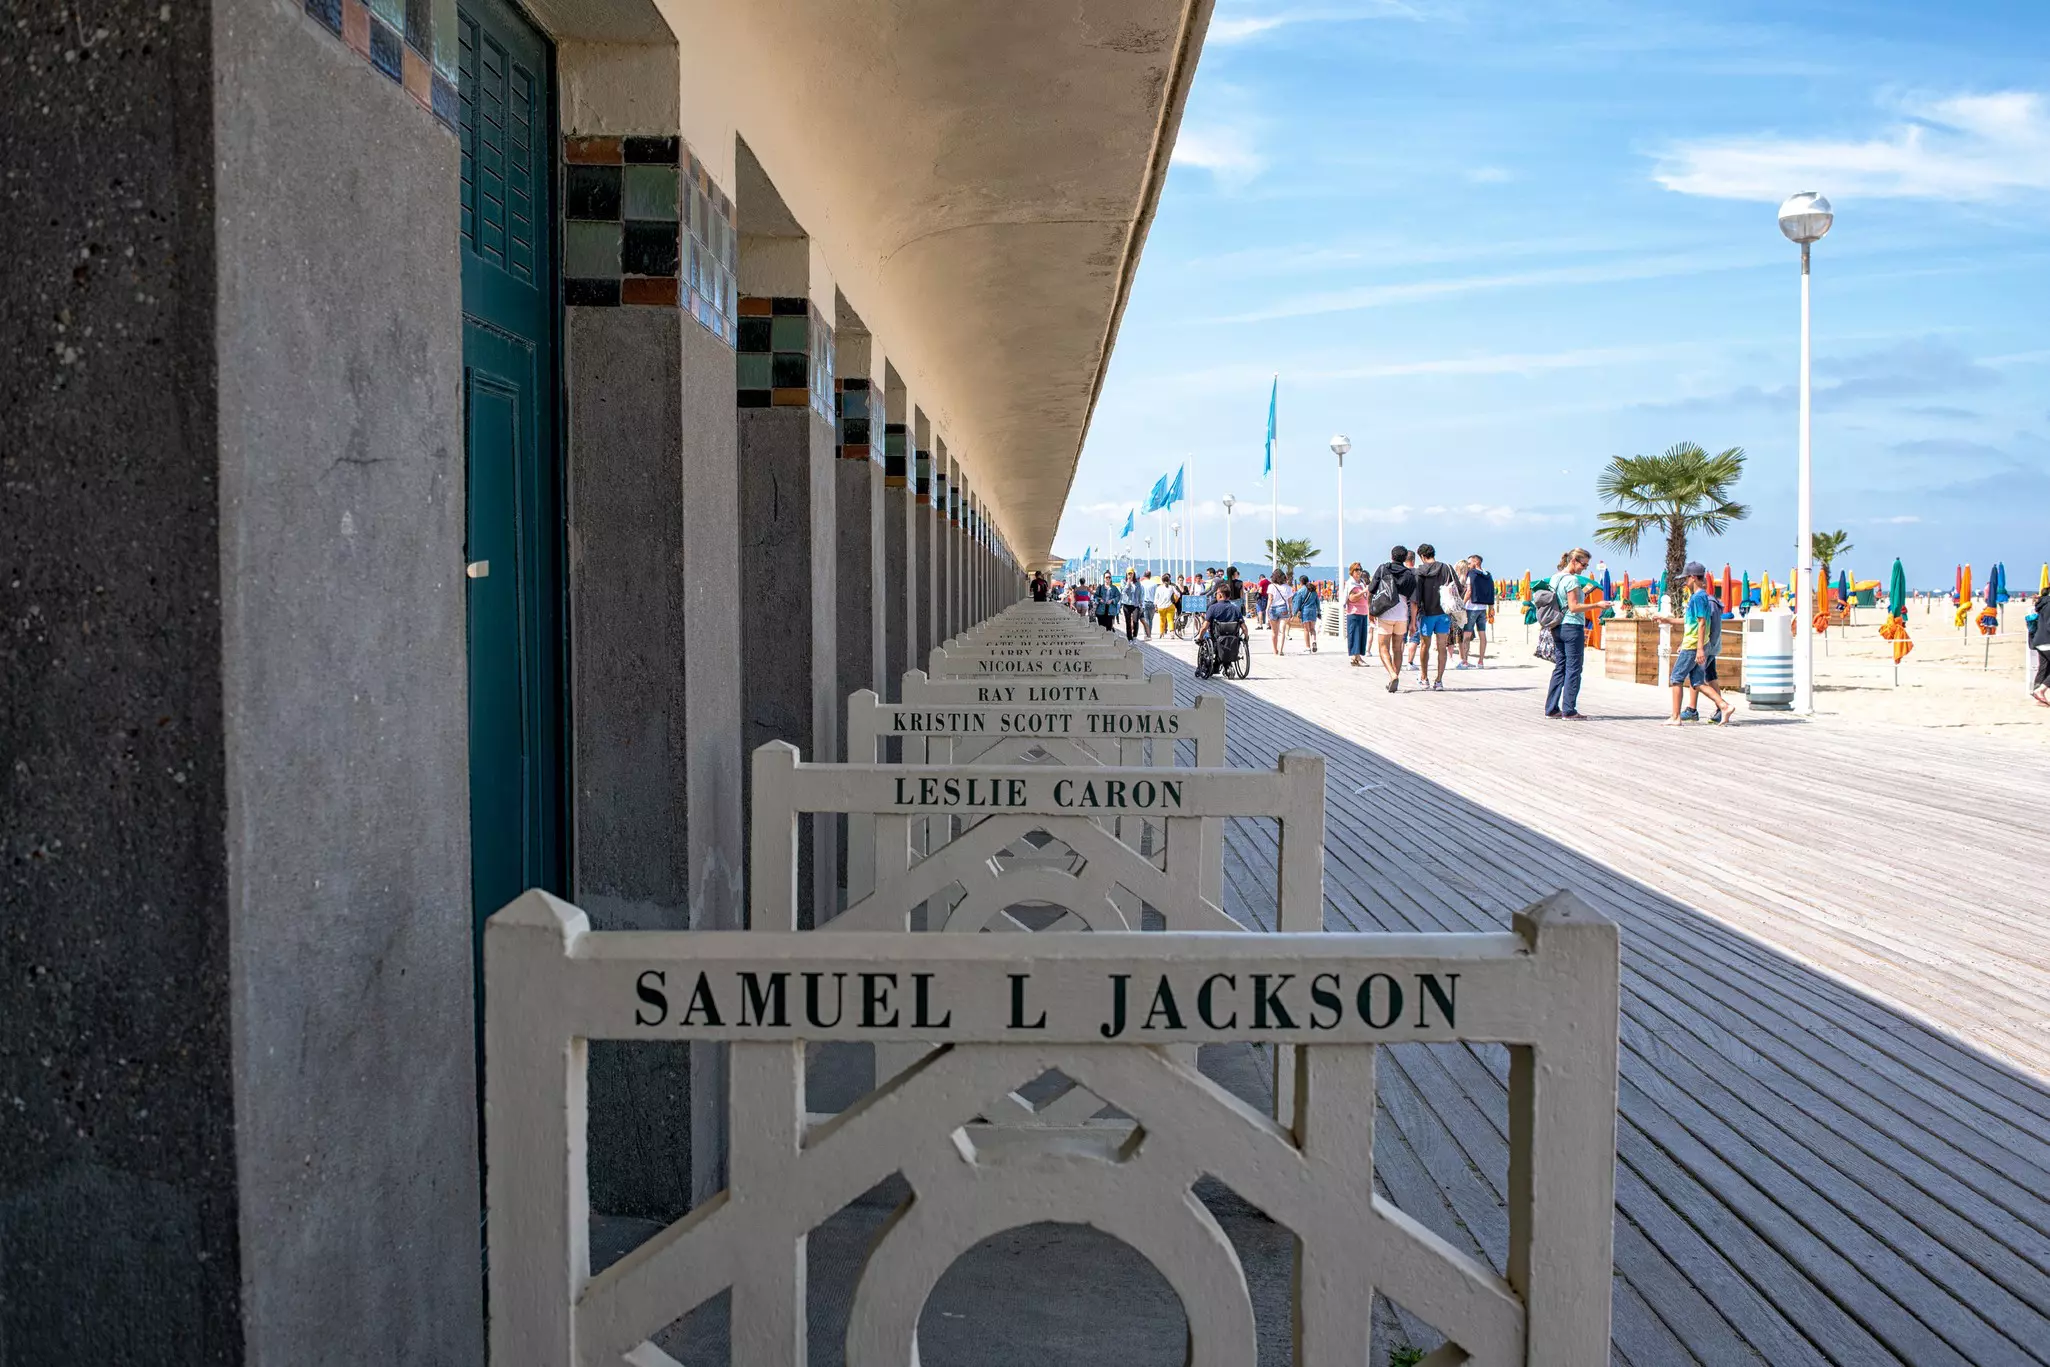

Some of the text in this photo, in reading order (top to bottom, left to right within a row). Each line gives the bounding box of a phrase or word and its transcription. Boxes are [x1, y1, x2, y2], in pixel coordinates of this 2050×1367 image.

[978, 660, 1093, 672] NICOLAS CAGE
[978, 687, 1100, 702] RAY LIOTTA
[893, 712, 1179, 734] KRISTIN SCOTT THOMAS
[894, 777, 1184, 809] LESLIE CARON
[634, 970, 1460, 1039] SAMUEL L JACKSON
